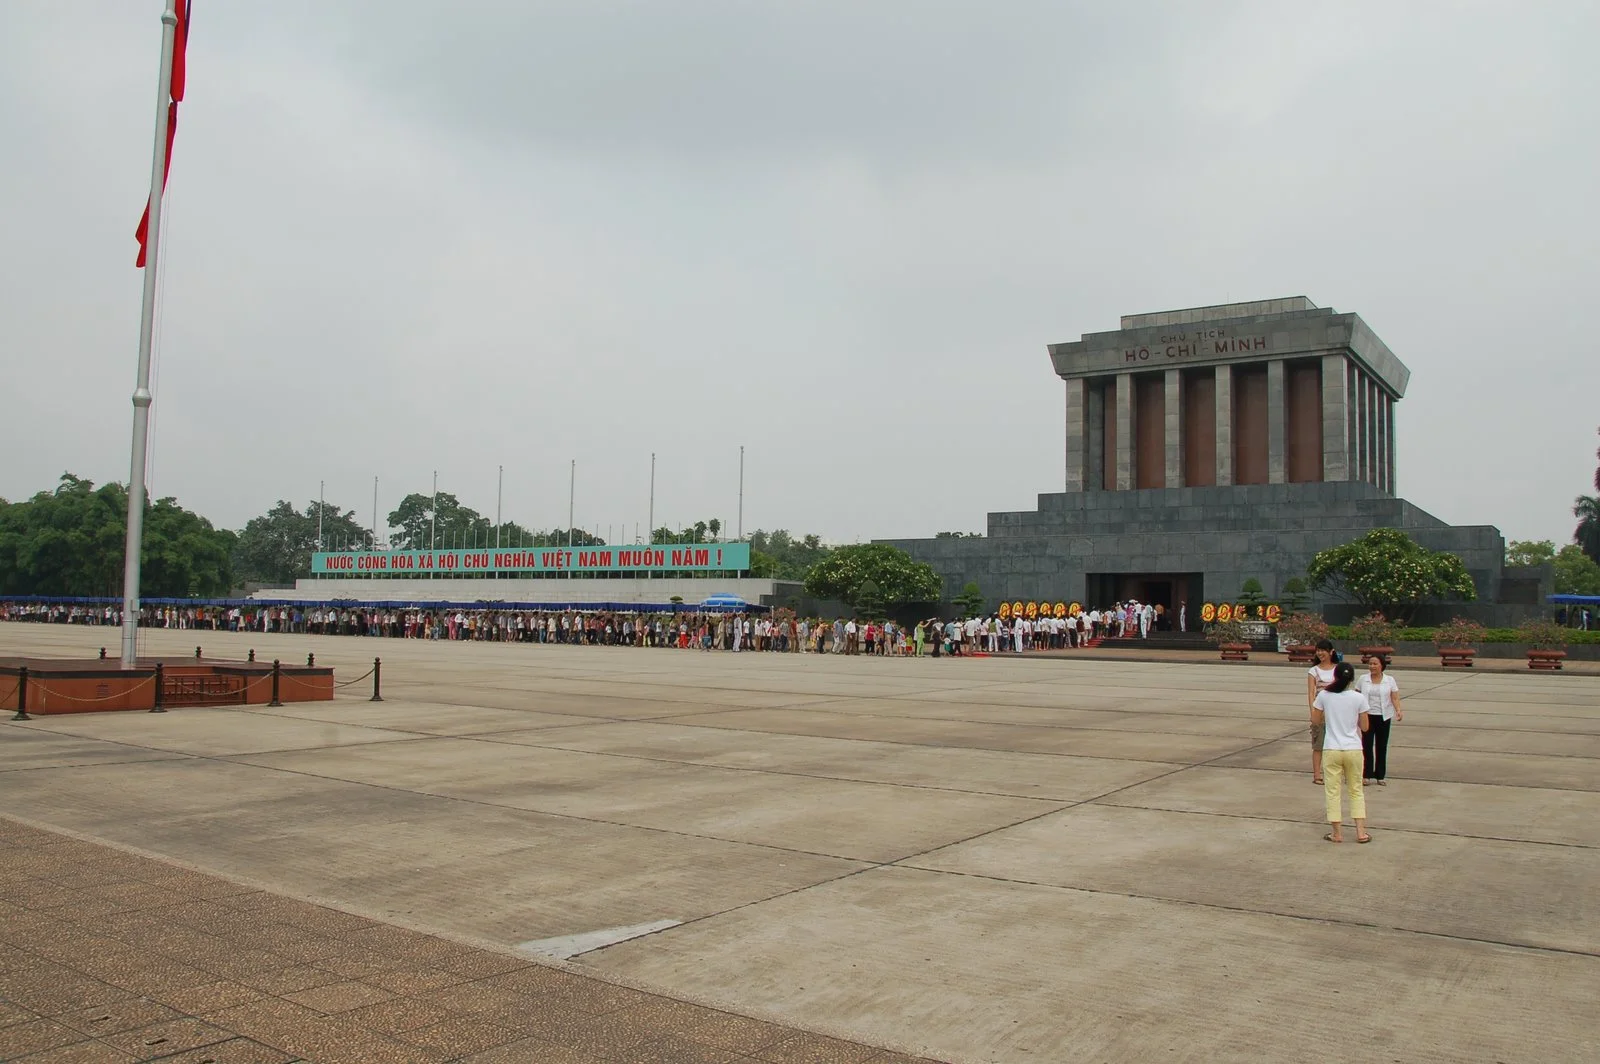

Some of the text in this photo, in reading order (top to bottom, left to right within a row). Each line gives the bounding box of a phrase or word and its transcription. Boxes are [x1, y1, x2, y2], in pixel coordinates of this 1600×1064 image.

[326, 554, 353, 569] NƯỚC
[357, 553, 387, 571] CỘNG
[418, 552, 434, 568] XÃ
[438, 551, 459, 570] HỘI
[464, 549, 489, 568] CHỦ
[494, 550, 535, 568] NGHĨA
[542, 548, 572, 569] VIỆT
[578, 551, 612, 567] NAM
[618, 547, 665, 566] MUÔN
[671, 545, 709, 566] NĂM
